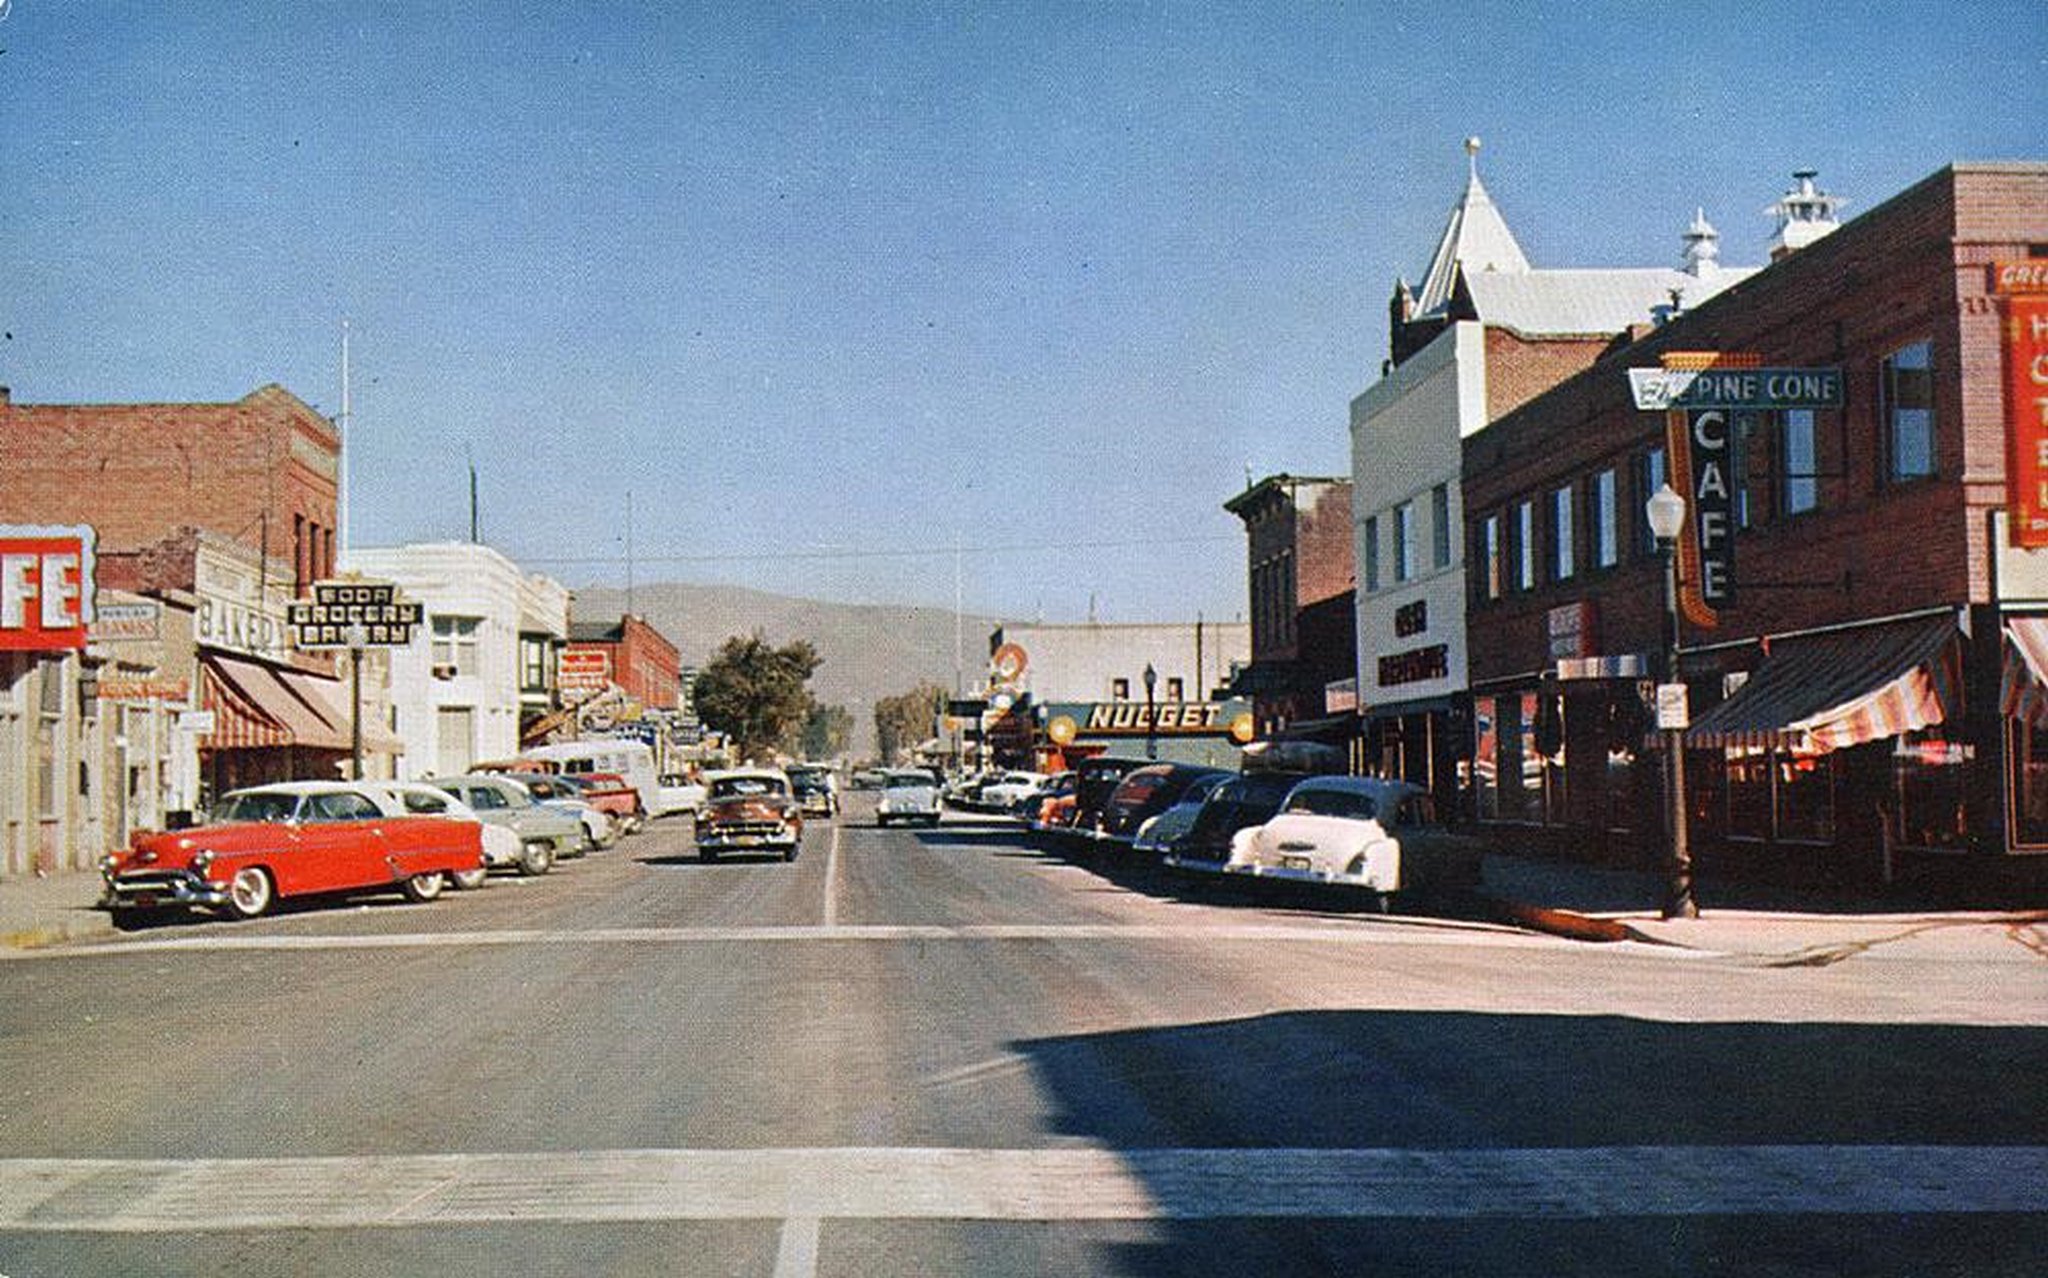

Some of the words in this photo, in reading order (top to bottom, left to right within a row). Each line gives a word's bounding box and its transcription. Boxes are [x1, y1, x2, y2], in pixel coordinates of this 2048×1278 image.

[1699, 376, 1756, 399] PINE
[1767, 375, 1836, 400] CONE
[1694, 411, 1728, 600] CAFE
[294, 605, 416, 623] GROCERY
[303, 625, 407, 644] BAKRY
[1089, 703, 1222, 728] NUGGET
